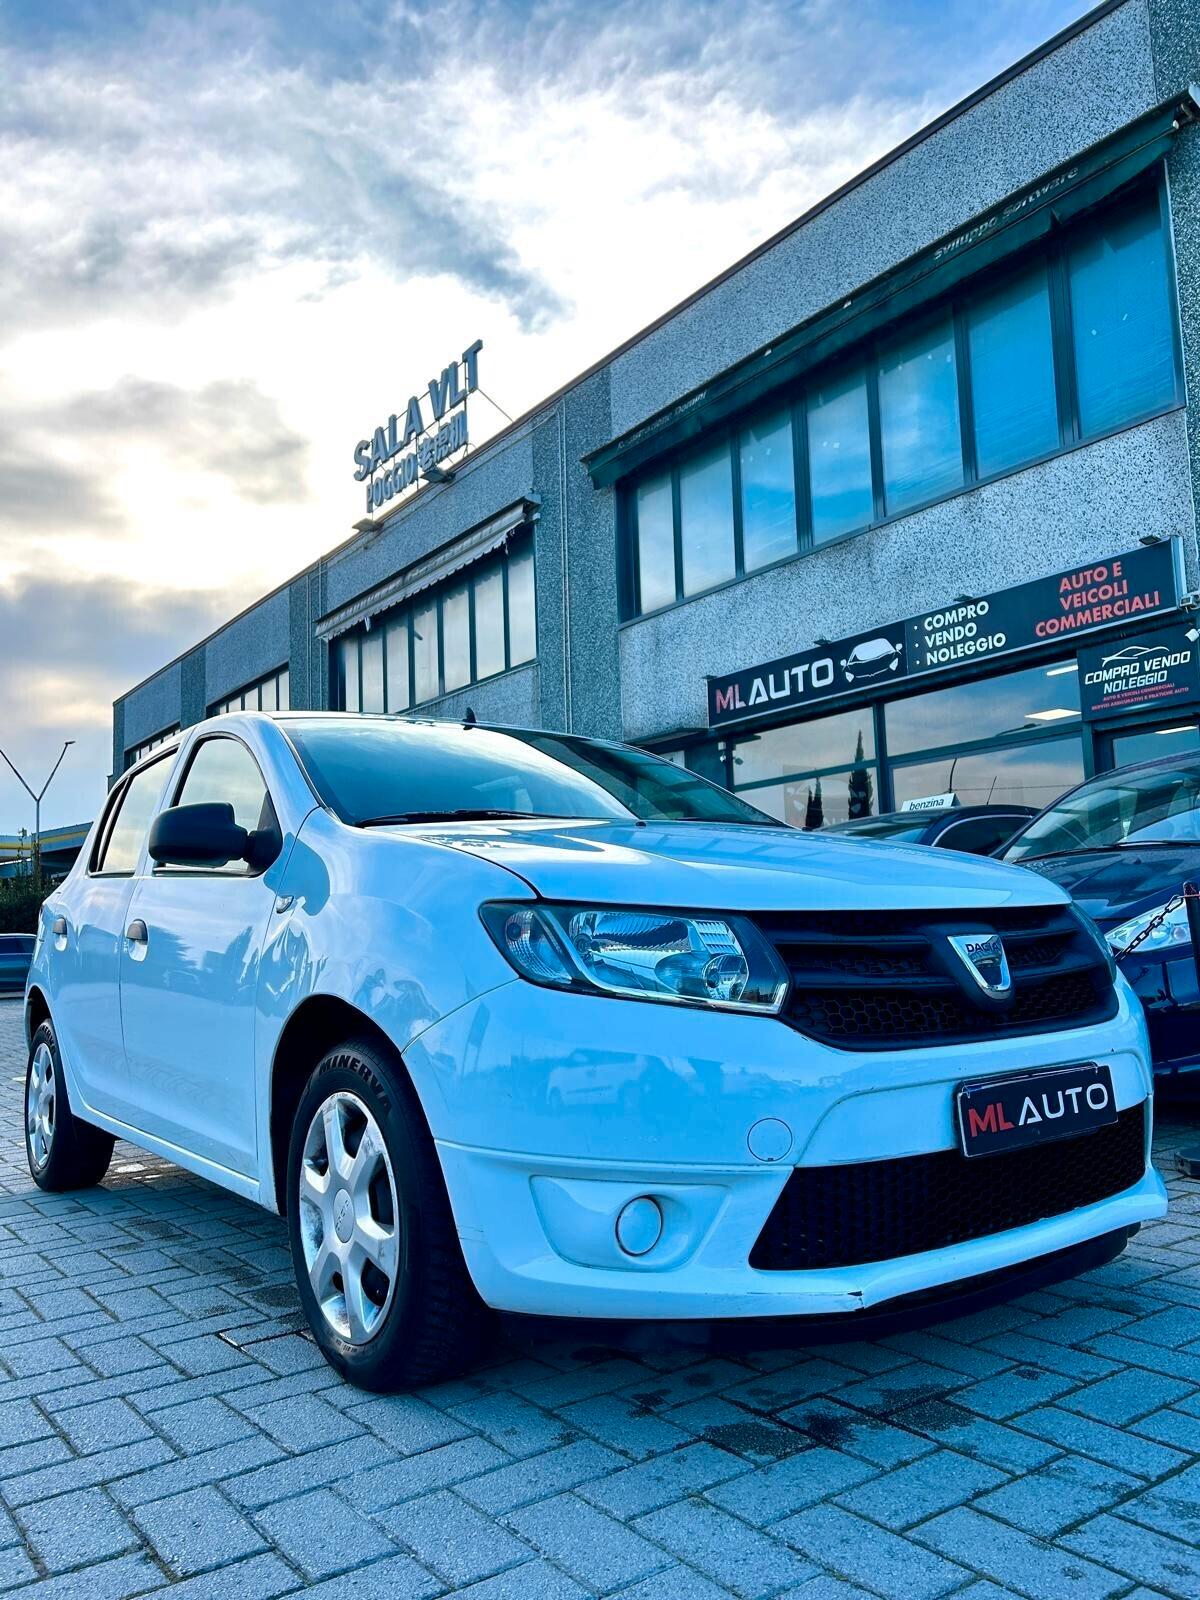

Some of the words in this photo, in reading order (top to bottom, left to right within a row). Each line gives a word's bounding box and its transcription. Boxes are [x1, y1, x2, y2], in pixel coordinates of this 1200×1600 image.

[353, 395, 424, 482] SALA
[428, 338, 484, 421] VLT
[366, 452, 418, 513] POGGIO
[1059, 565, 1108, 593] AUTO
[1112, 560, 1123, 578] E
[1060, 579, 1128, 611] VEICOLI
[924, 601, 990, 632] COMPRO
[1035, 591, 1161, 638] COMMERCIALI
[924, 622, 978, 649] VENDO
[926, 632, 1007, 666] NOLEGGIO
[1084, 662, 1140, 685] COMPRO
[1143, 650, 1191, 672] VENDO
[1103, 670, 1168, 695] NOLEGGIO
[715, 683, 746, 714] ML
[749, 657, 834, 706] AUTO
[909, 798, 945, 811] benzina
[965, 942, 1000, 953] DACIA
[319, 1054, 392, 1119] MINERVA
[968, 1102, 1015, 1138] ML
[1018, 1083, 1109, 1126] AUTO
